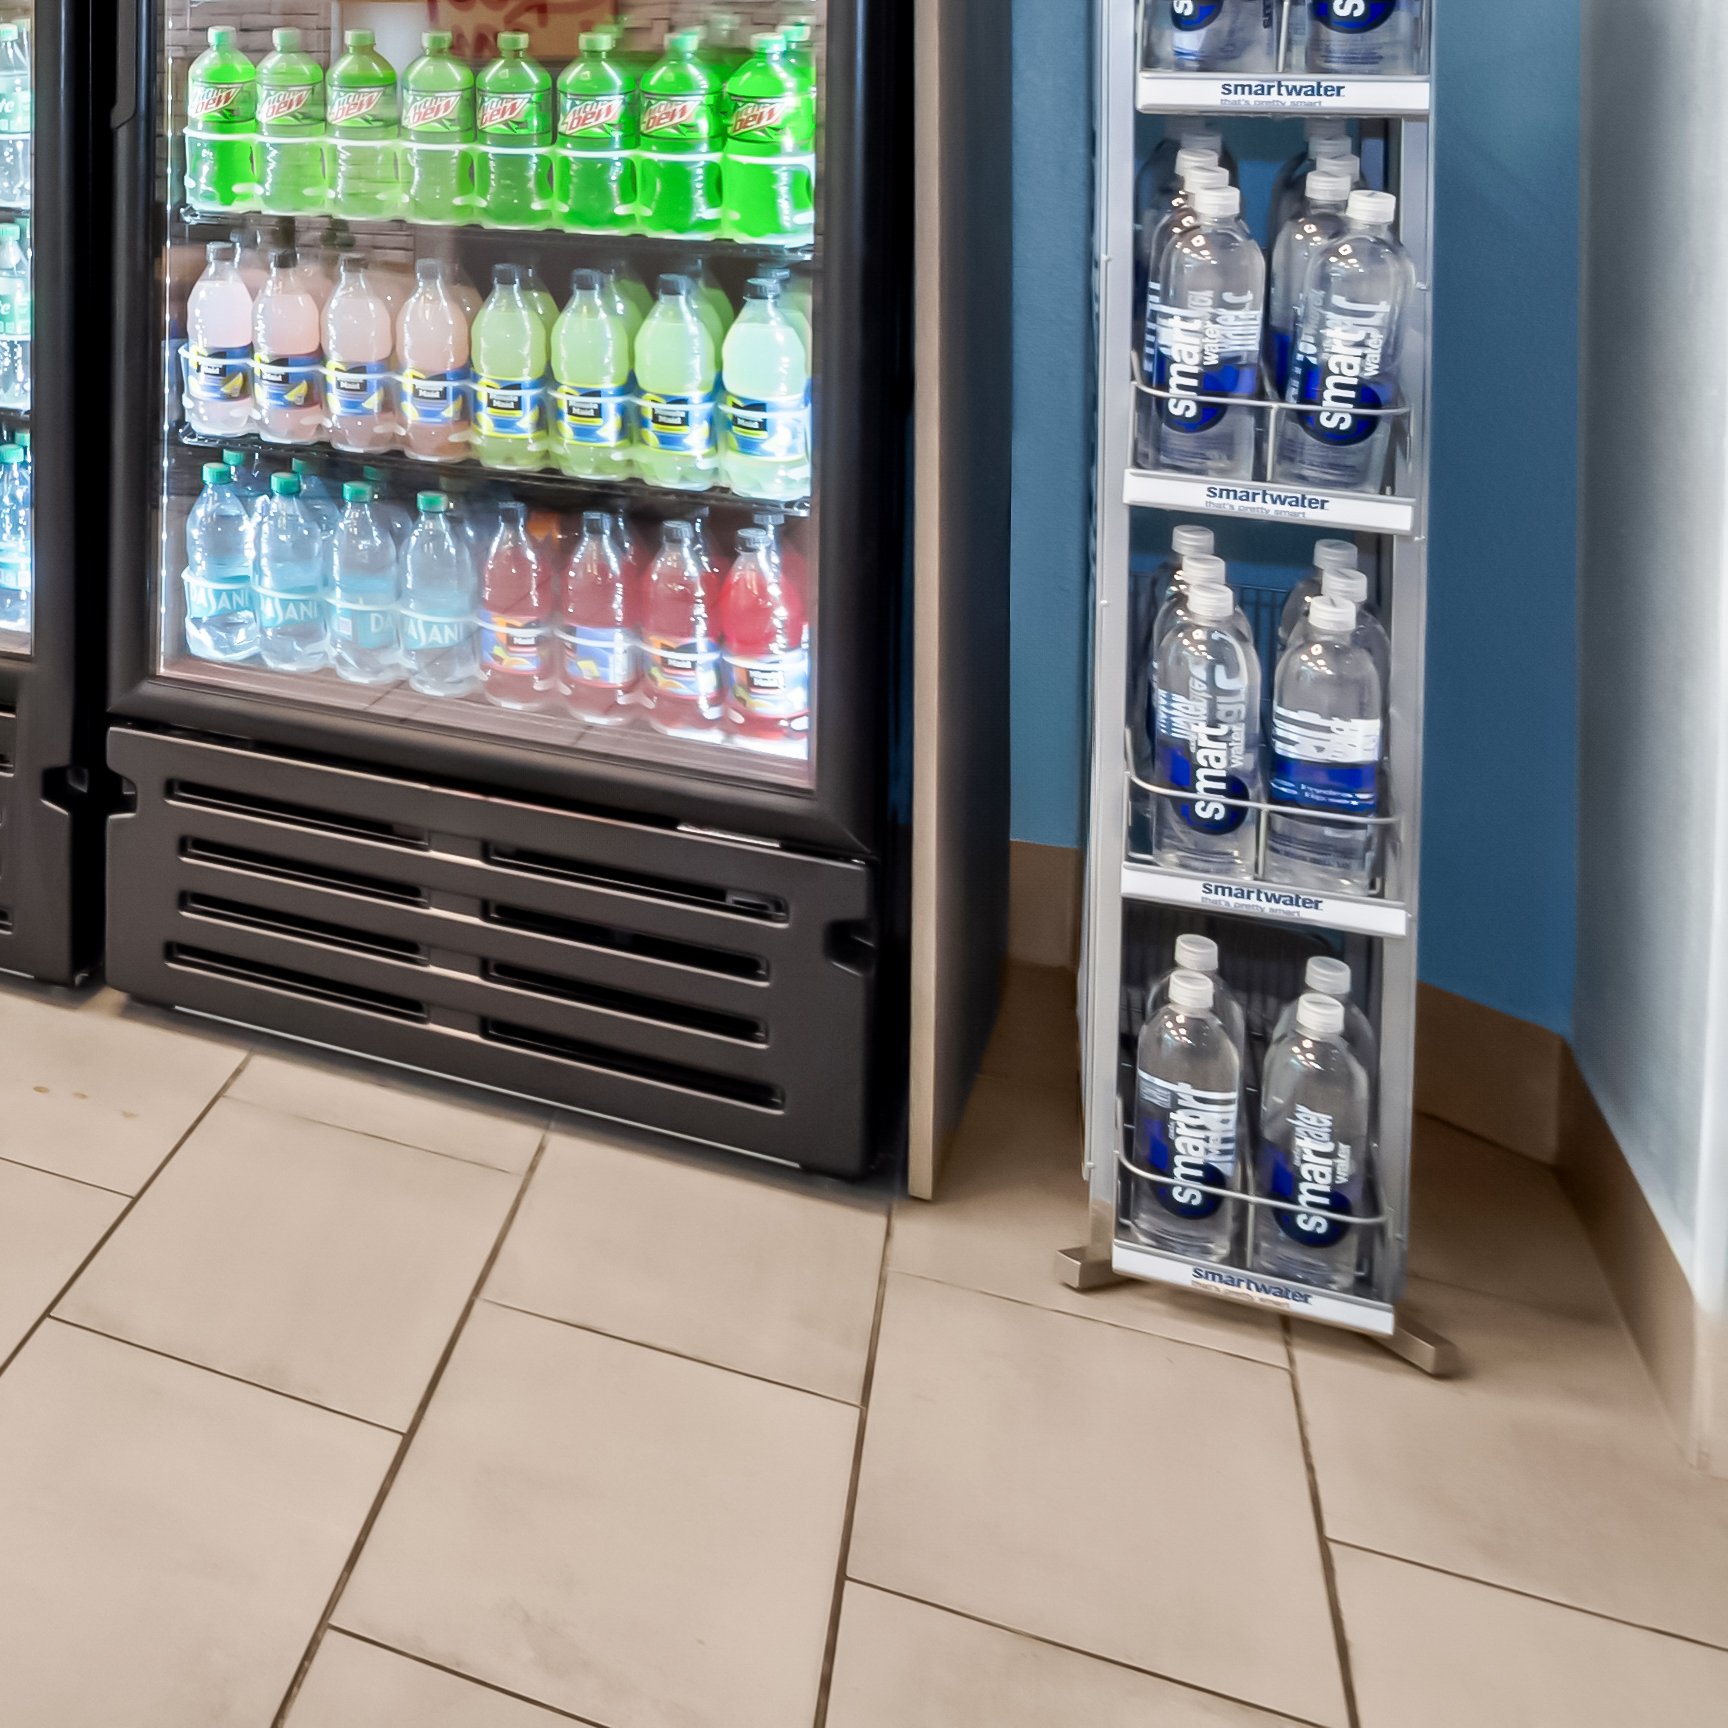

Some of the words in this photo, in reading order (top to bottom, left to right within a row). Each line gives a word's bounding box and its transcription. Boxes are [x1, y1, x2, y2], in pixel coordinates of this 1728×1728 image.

[1220, 80, 1346, 98] smartwater
[1167, 315, 1203, 418] smart
[1319, 325, 1361, 430] smart
[1205, 485, 1330, 511] smartwater
[1194, 722, 1229, 821] smart
[1201, 882, 1324, 910] smartwater
[1171, 1112, 1206, 1206] smart
[1295, 1136, 1334, 1234] smart
[1191, 1266, 1313, 1305] smartwater
